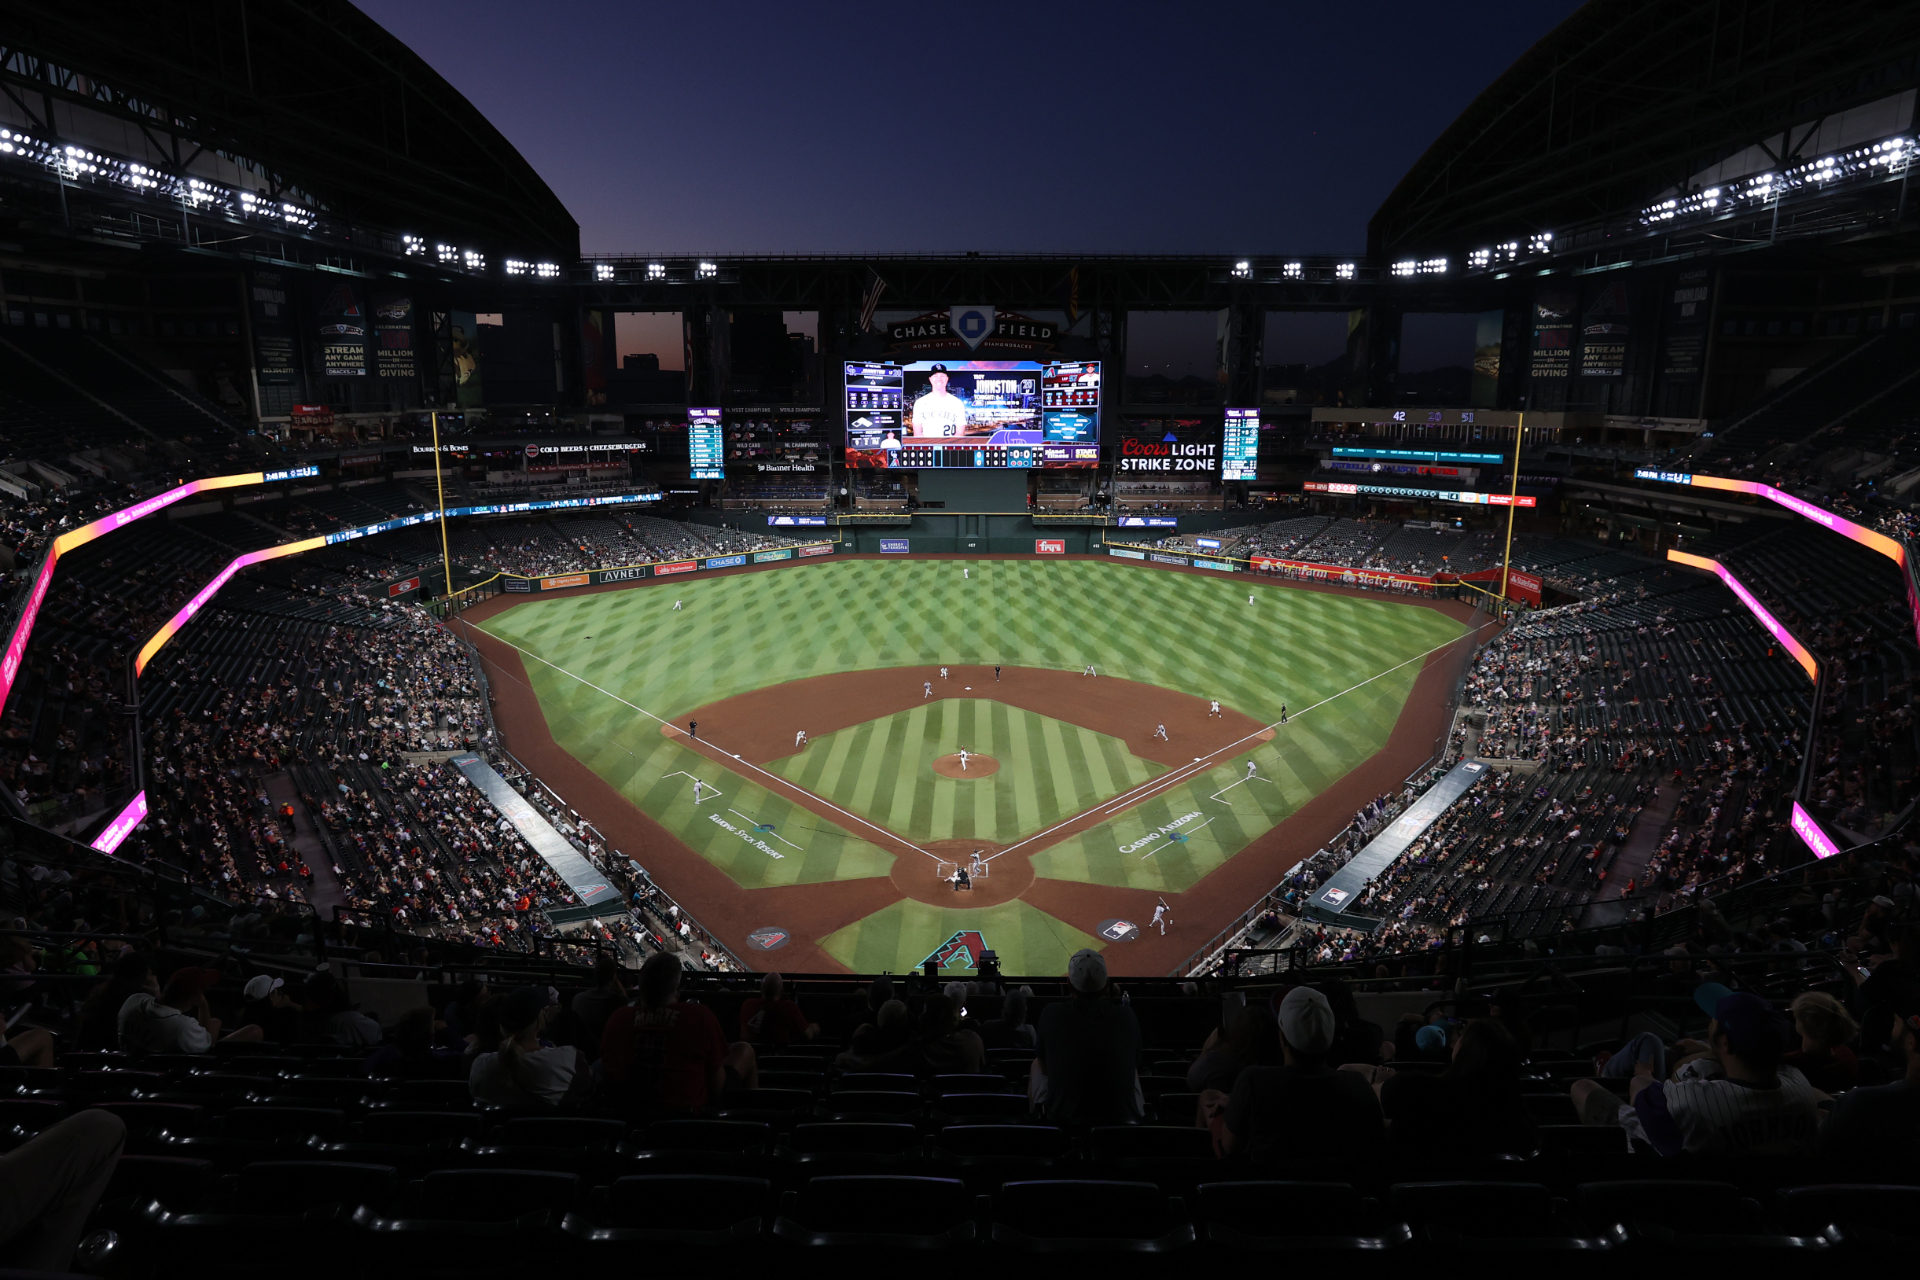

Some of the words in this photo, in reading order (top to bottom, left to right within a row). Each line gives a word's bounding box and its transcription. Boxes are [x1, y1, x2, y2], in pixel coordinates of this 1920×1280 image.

[893, 323, 947, 339] CHASE
[998, 323, 1052, 339] FIELD
[324, 346, 364, 354] STREAM
[377, 349, 414, 357] MILLION
[1533, 349, 1570, 357] MILLION
[1584, 346, 1625, 354] STREAM
[379, 369, 415, 377] GIVING
[1531, 369, 1568, 377] GIVING
[973, 379, 1017, 394] JOHNSTON
[1392, 410, 1406, 421] 42
[1427, 411, 1443, 422] 20
[1461, 411, 1475, 423] 51
[943, 424, 956, 436] 20
[540, 446, 559, 454] COLD
[560, 445, 583, 453] BEERS
[589, 443, 647, 452] CHEESEBURGERS
[1121, 438, 1169, 456] Coors
[1171, 444, 1216, 456] LIGHT
[766, 464, 791, 472] Banner
[791, 464, 815, 472] Health
[1121, 458, 1171, 471] STRIKE
[1175, 458, 1216, 471] ZONE
[1039, 540, 1062, 553] fry's
[710, 558, 734, 567] CHASE
[1198, 560, 1213, 568] COX
[604, 567, 641, 581] AVNET
[1118, 832, 1161, 854] CASINO
[1157, 810, 1204, 835] ARIZONA
[1795, 811, 1814, 841] We're
[1813, 833, 1830, 857] Here
[734, 829, 756, 844] STICK
[753, 839, 785, 860] RESORT
